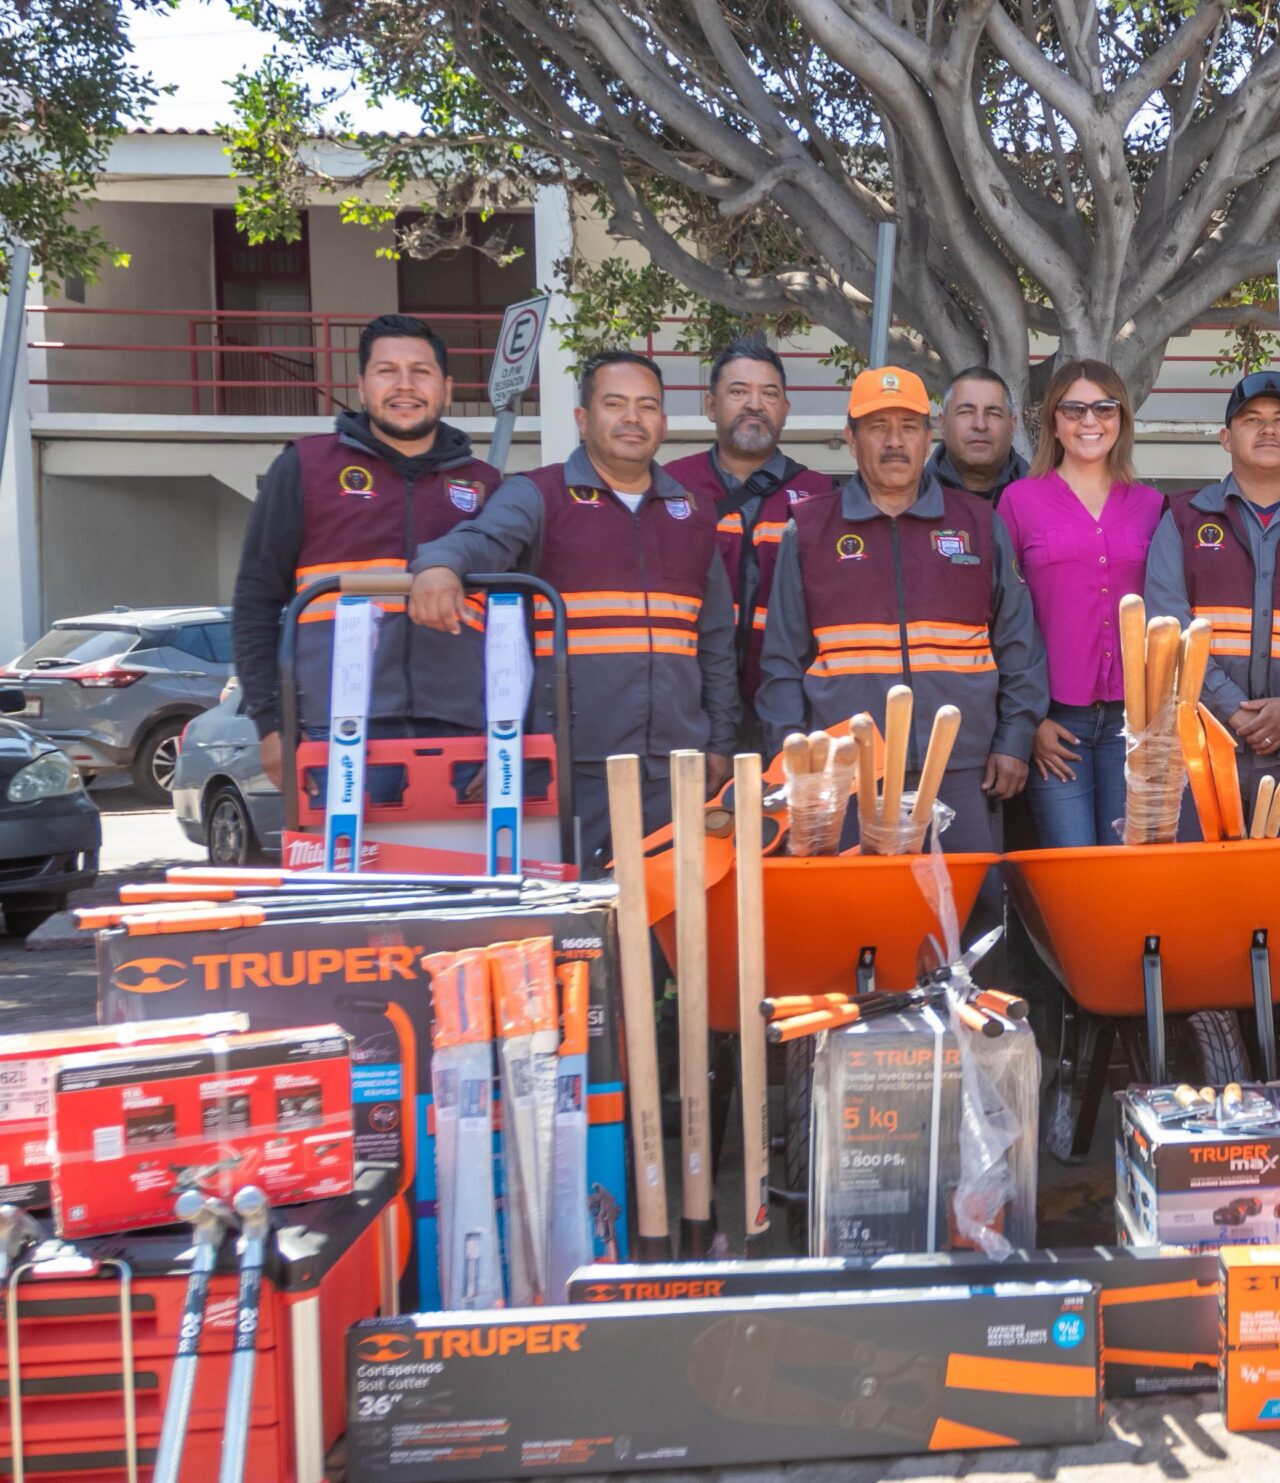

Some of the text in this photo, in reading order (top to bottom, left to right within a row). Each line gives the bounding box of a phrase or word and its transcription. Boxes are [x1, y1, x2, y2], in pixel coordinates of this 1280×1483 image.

[510, 318, 530, 355] E
[340, 755, 355, 803] Empire
[499, 749, 512, 796] Empire
[561, 938, 602, 949] 16095
[192, 946, 419, 990] TRUPER
[588, 1010, 604, 1024] SI
[874, 1050, 961, 1066] TRUPR
[842, 1106, 898, 1132] 5 kg
[853, 1155, 880, 1166] 800
[1190, 1144, 1268, 1164] TRUPER
[1230, 1154, 1280, 1174] max
[1219, 1227, 1227, 1238] 2
[620, 1280, 721, 1300] TRUPER
[414, 1323, 582, 1360] TRUPER
[357, 1362, 444, 1378] Cortapernos
[357, 1377, 430, 1393] Bolt cutter
